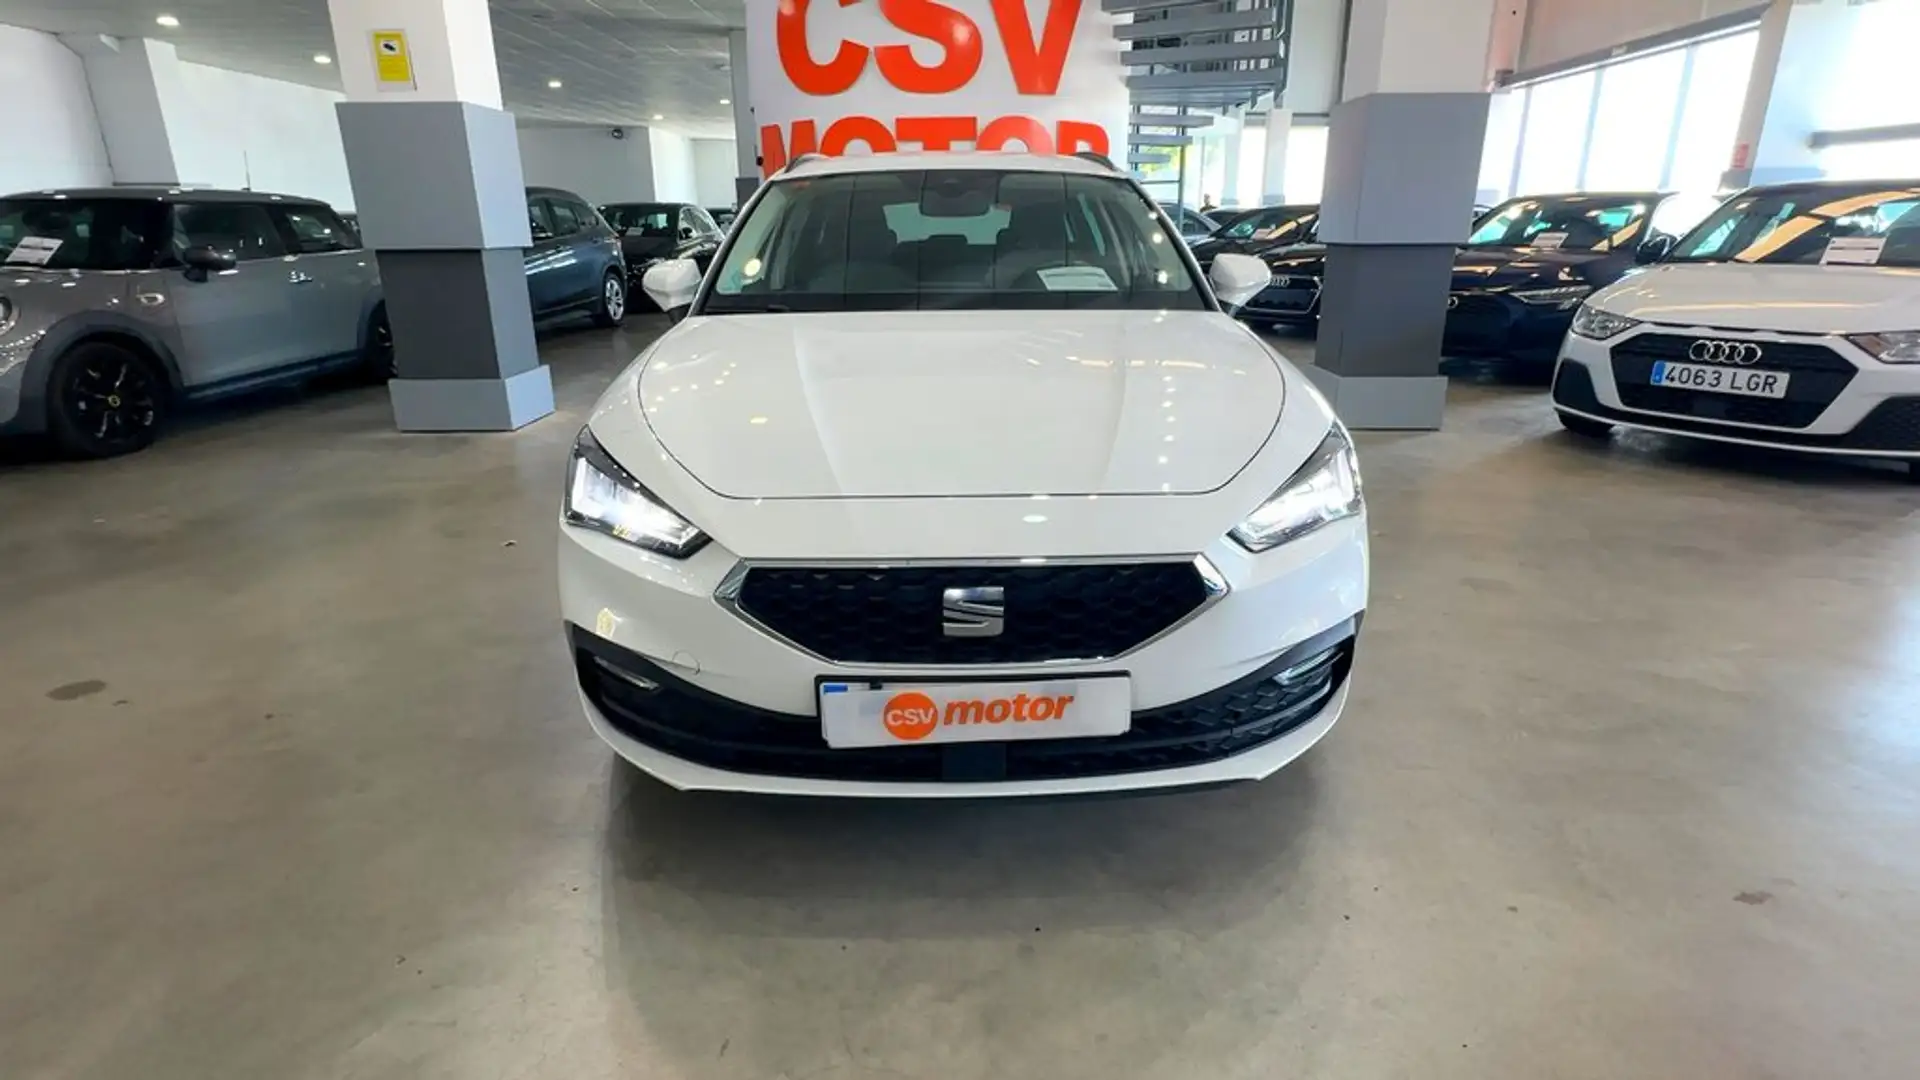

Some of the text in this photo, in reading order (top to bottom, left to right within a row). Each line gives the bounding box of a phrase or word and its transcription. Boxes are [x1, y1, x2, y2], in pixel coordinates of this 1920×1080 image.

[777, 0, 1082, 96] CSV
[1665, 366, 1778, 393] 4063 LGR
[886, 694, 1075, 726] CSV motor
